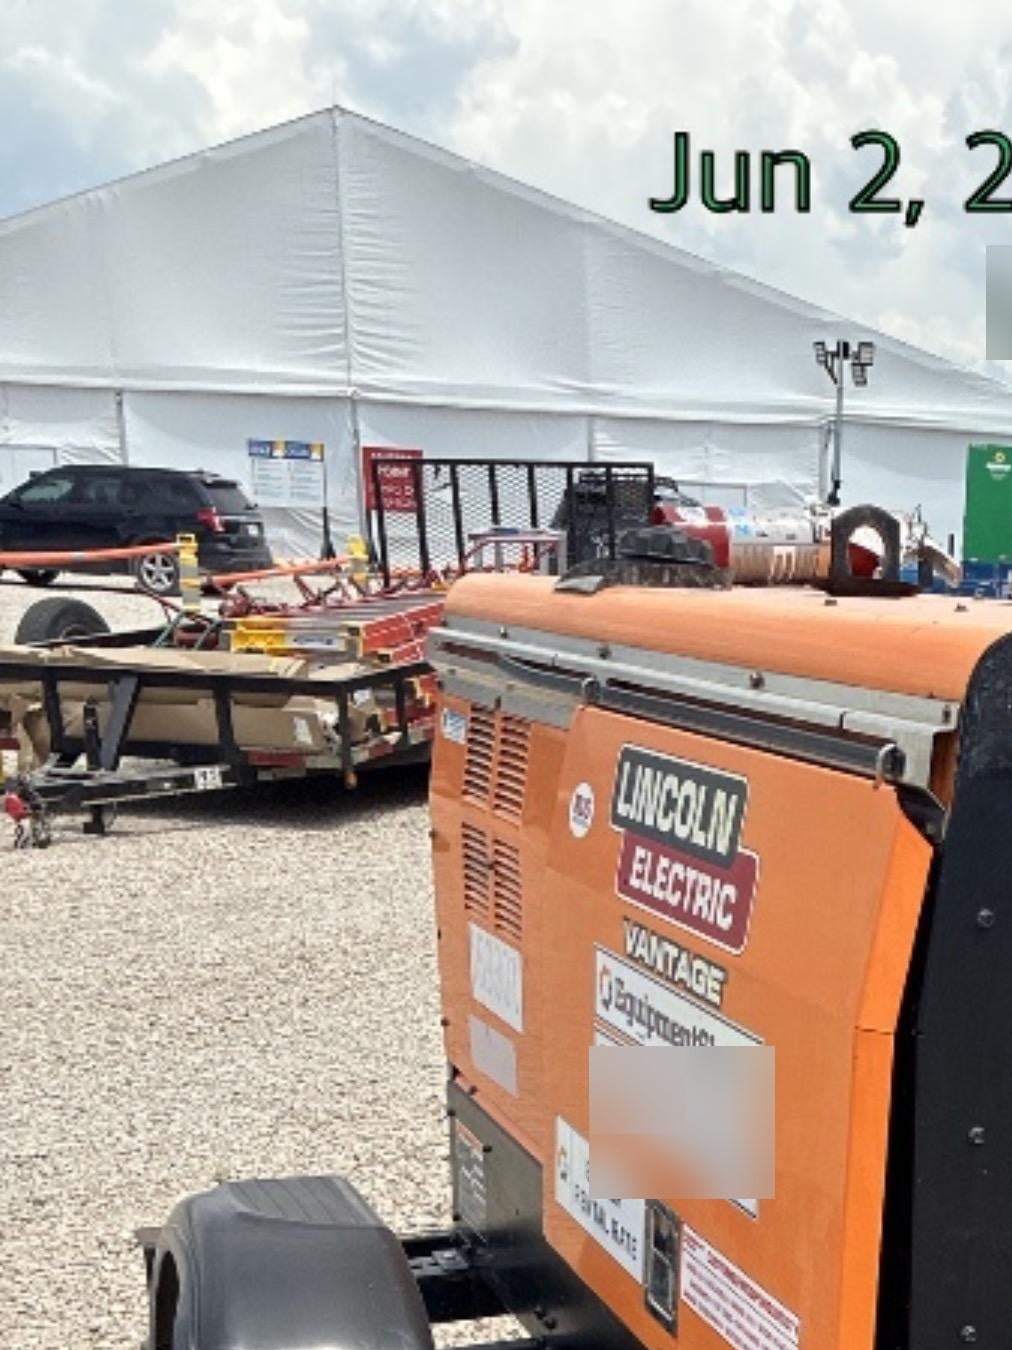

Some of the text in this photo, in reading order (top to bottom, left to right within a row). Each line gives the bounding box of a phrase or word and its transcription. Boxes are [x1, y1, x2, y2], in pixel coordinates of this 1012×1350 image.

[617, 761, 738, 857] LINCOLN
[629, 845, 738, 931] ELECTRIC
[624, 920, 727, 1005] VANTAGE
